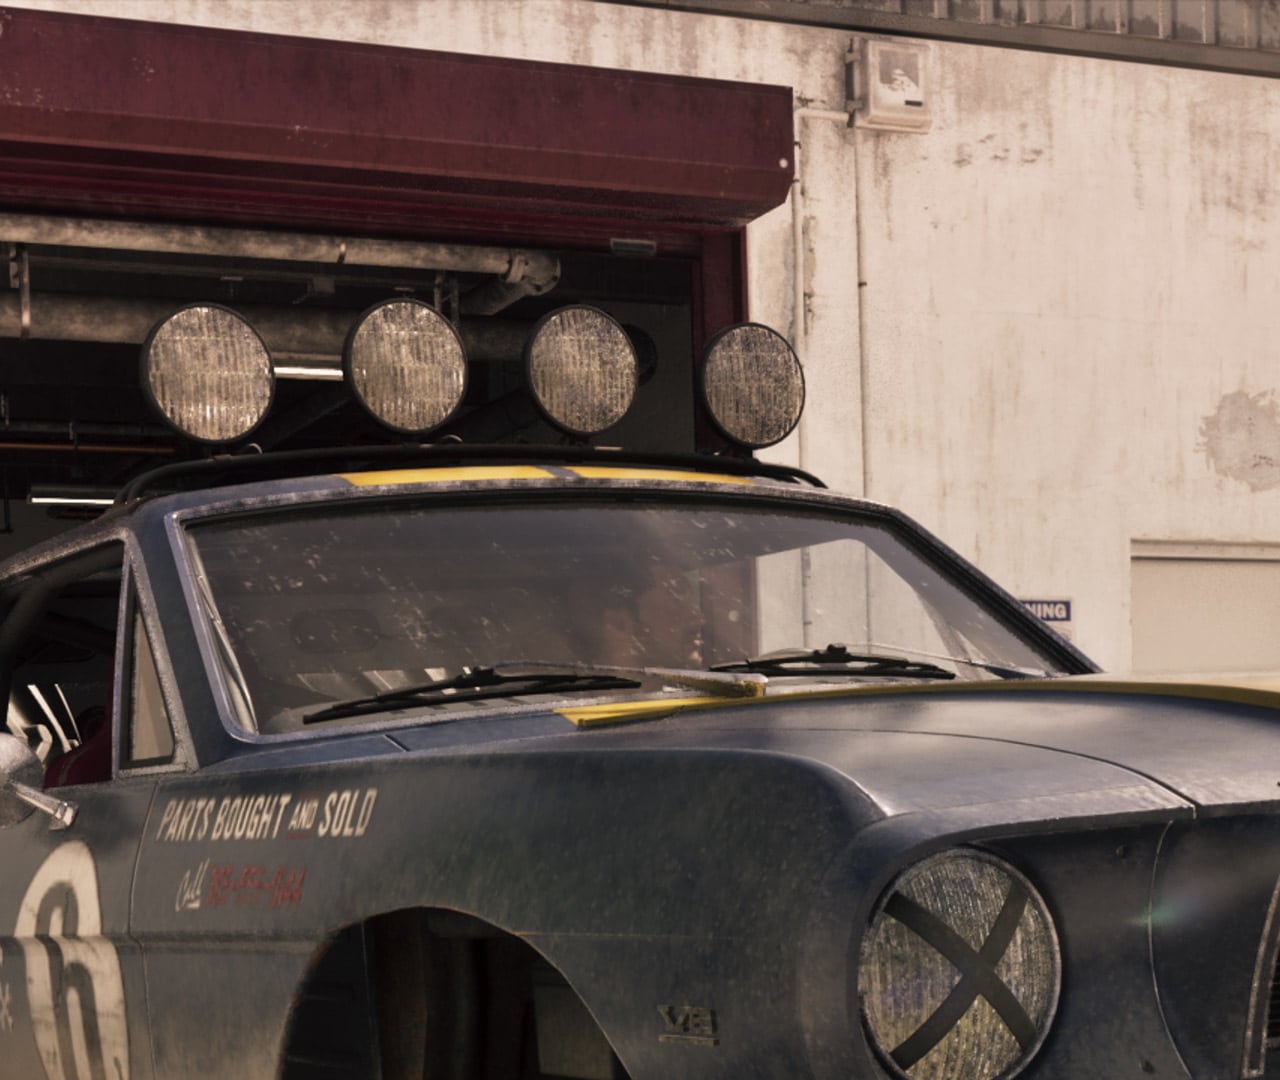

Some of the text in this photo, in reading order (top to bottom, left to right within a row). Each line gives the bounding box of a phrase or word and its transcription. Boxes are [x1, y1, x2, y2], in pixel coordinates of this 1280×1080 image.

[156, 788, 378, 841] PARTS BOUGHT AND SOLD
